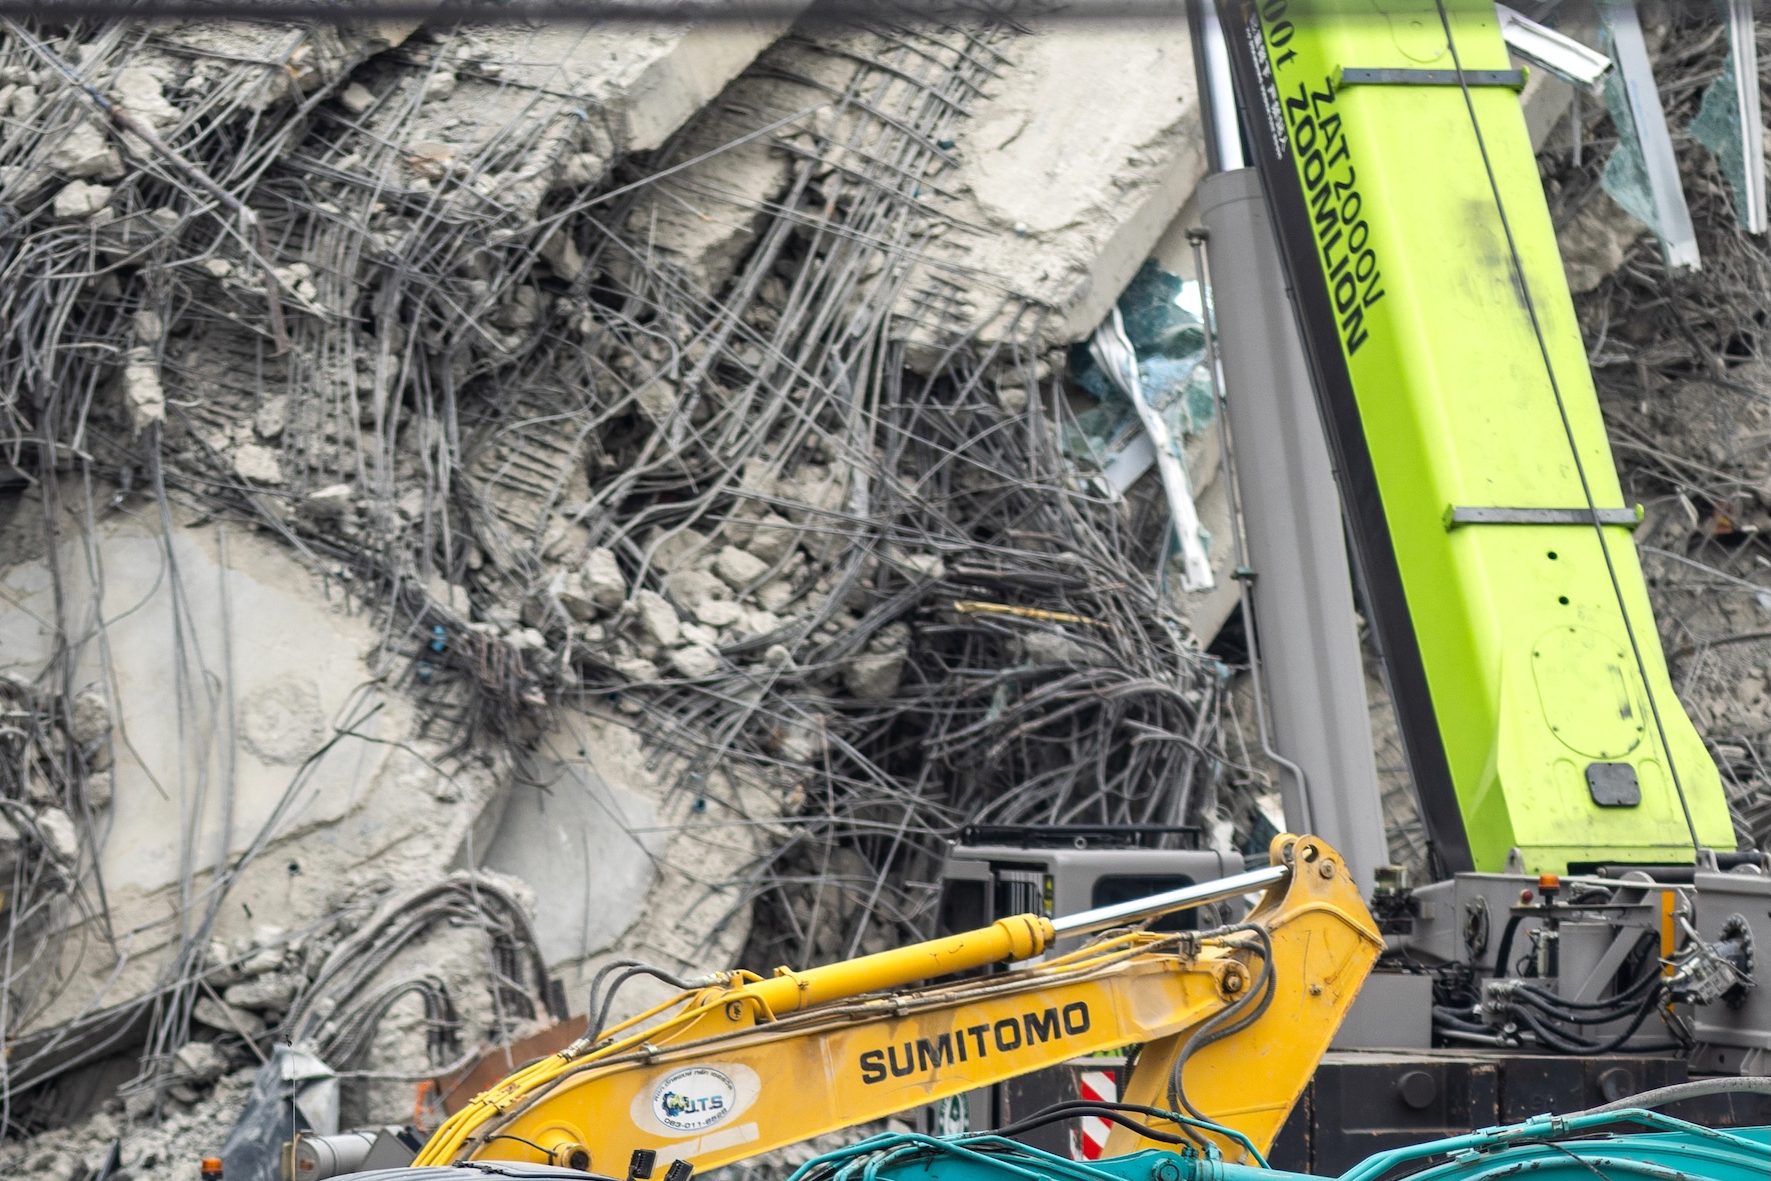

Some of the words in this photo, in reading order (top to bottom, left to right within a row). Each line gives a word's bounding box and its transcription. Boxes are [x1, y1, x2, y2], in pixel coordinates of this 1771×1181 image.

[1286, 81, 1369, 357] ZOOMLION
[1311, 76, 1386, 310] ZAT2000V
[859, 1001, 1091, 1085] SUMITOMO
